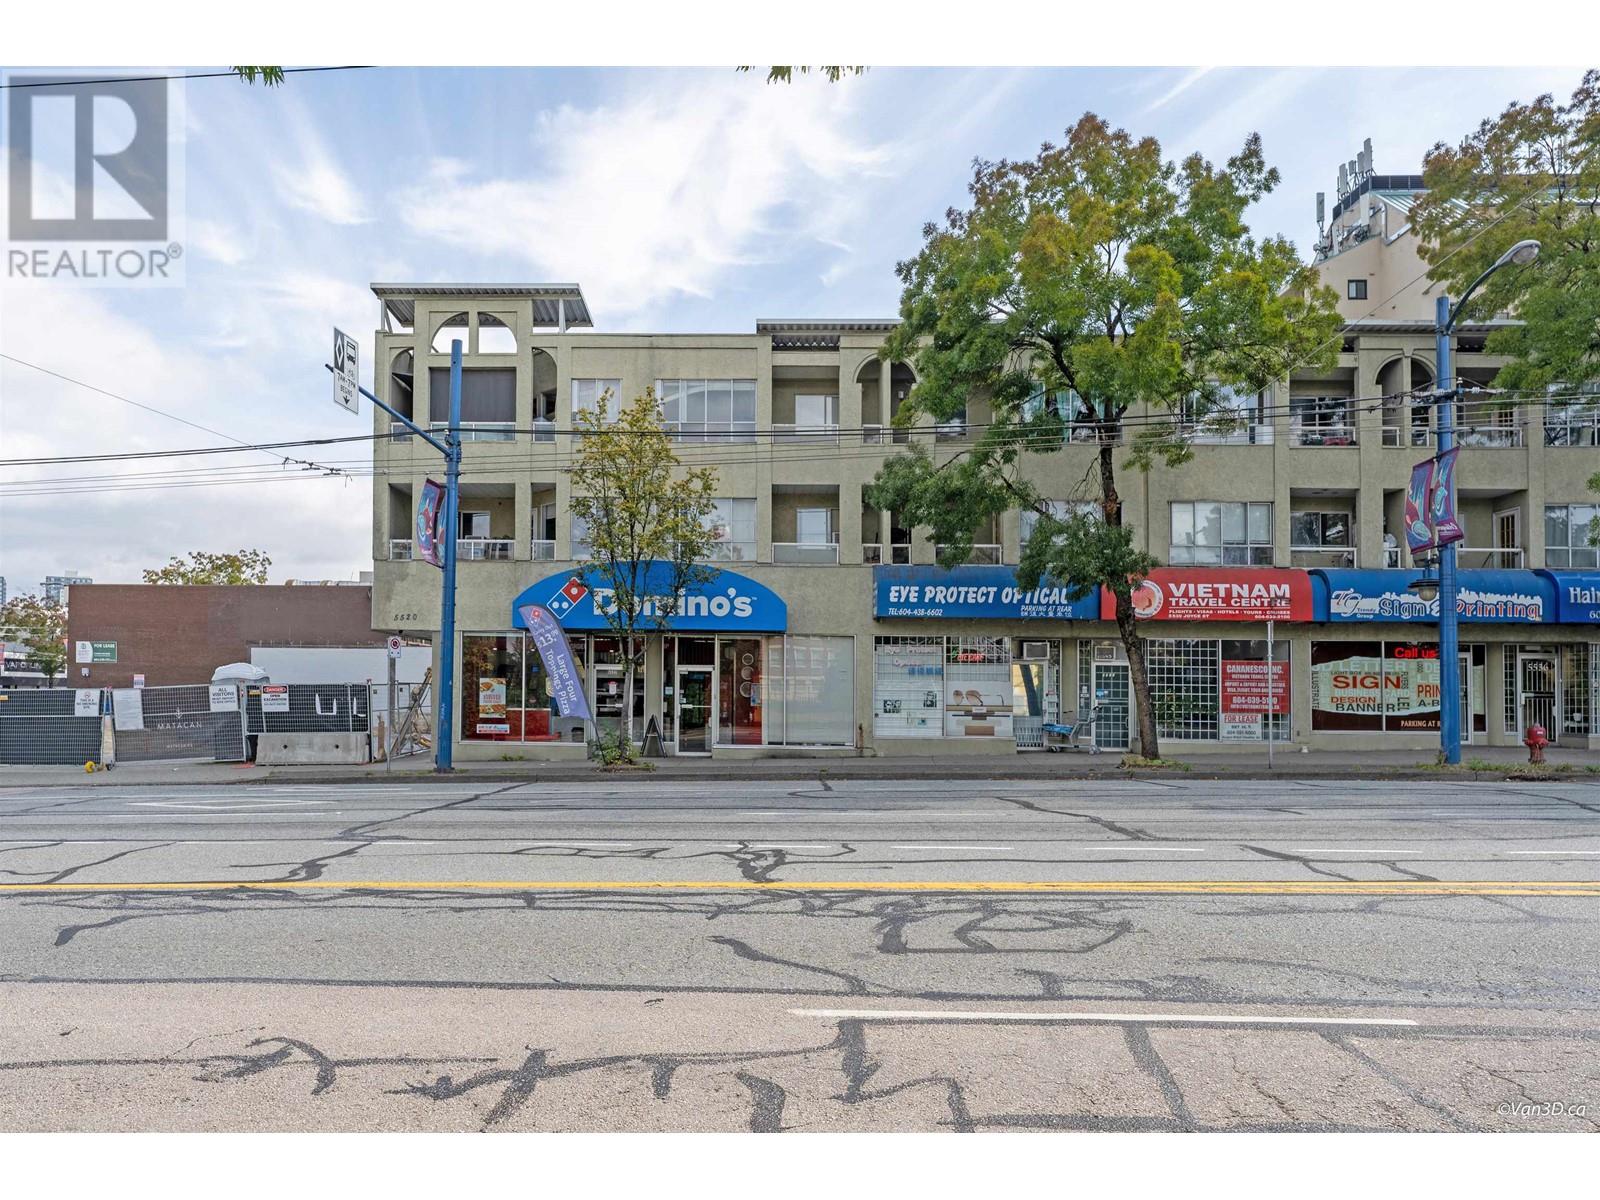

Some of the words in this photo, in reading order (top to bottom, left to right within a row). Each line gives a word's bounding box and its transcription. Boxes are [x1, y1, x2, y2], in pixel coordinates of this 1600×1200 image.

[889, 585, 919, 603] EYE
[924, 586, 997, 604] PROTECT
[1168, 583, 1290, 598] VIETNAM
[593, 587, 753, 617] Domino's
[1168, 598, 1227, 607] TRAVEL
[1231, 598, 1291, 607] CENTRE
[1380, 599, 1425, 619] Sign
[393, 613, 418, 621] 5520
[1394, 646, 1418, 658] Call
[1421, 649, 1437, 658] us
[556, 654, 570, 680] Large
[566, 680, 577, 702] Four
[1333, 675, 1401, 689] SIGN
[1311, 671, 1320, 709] ILLUSTRATE
[1331, 696, 1376, 704] DESIGN
[1336, 703, 1396, 713] BANNER
[1224, 715, 1235, 723] FOR
[1235, 715, 1259, 723] LEASE
